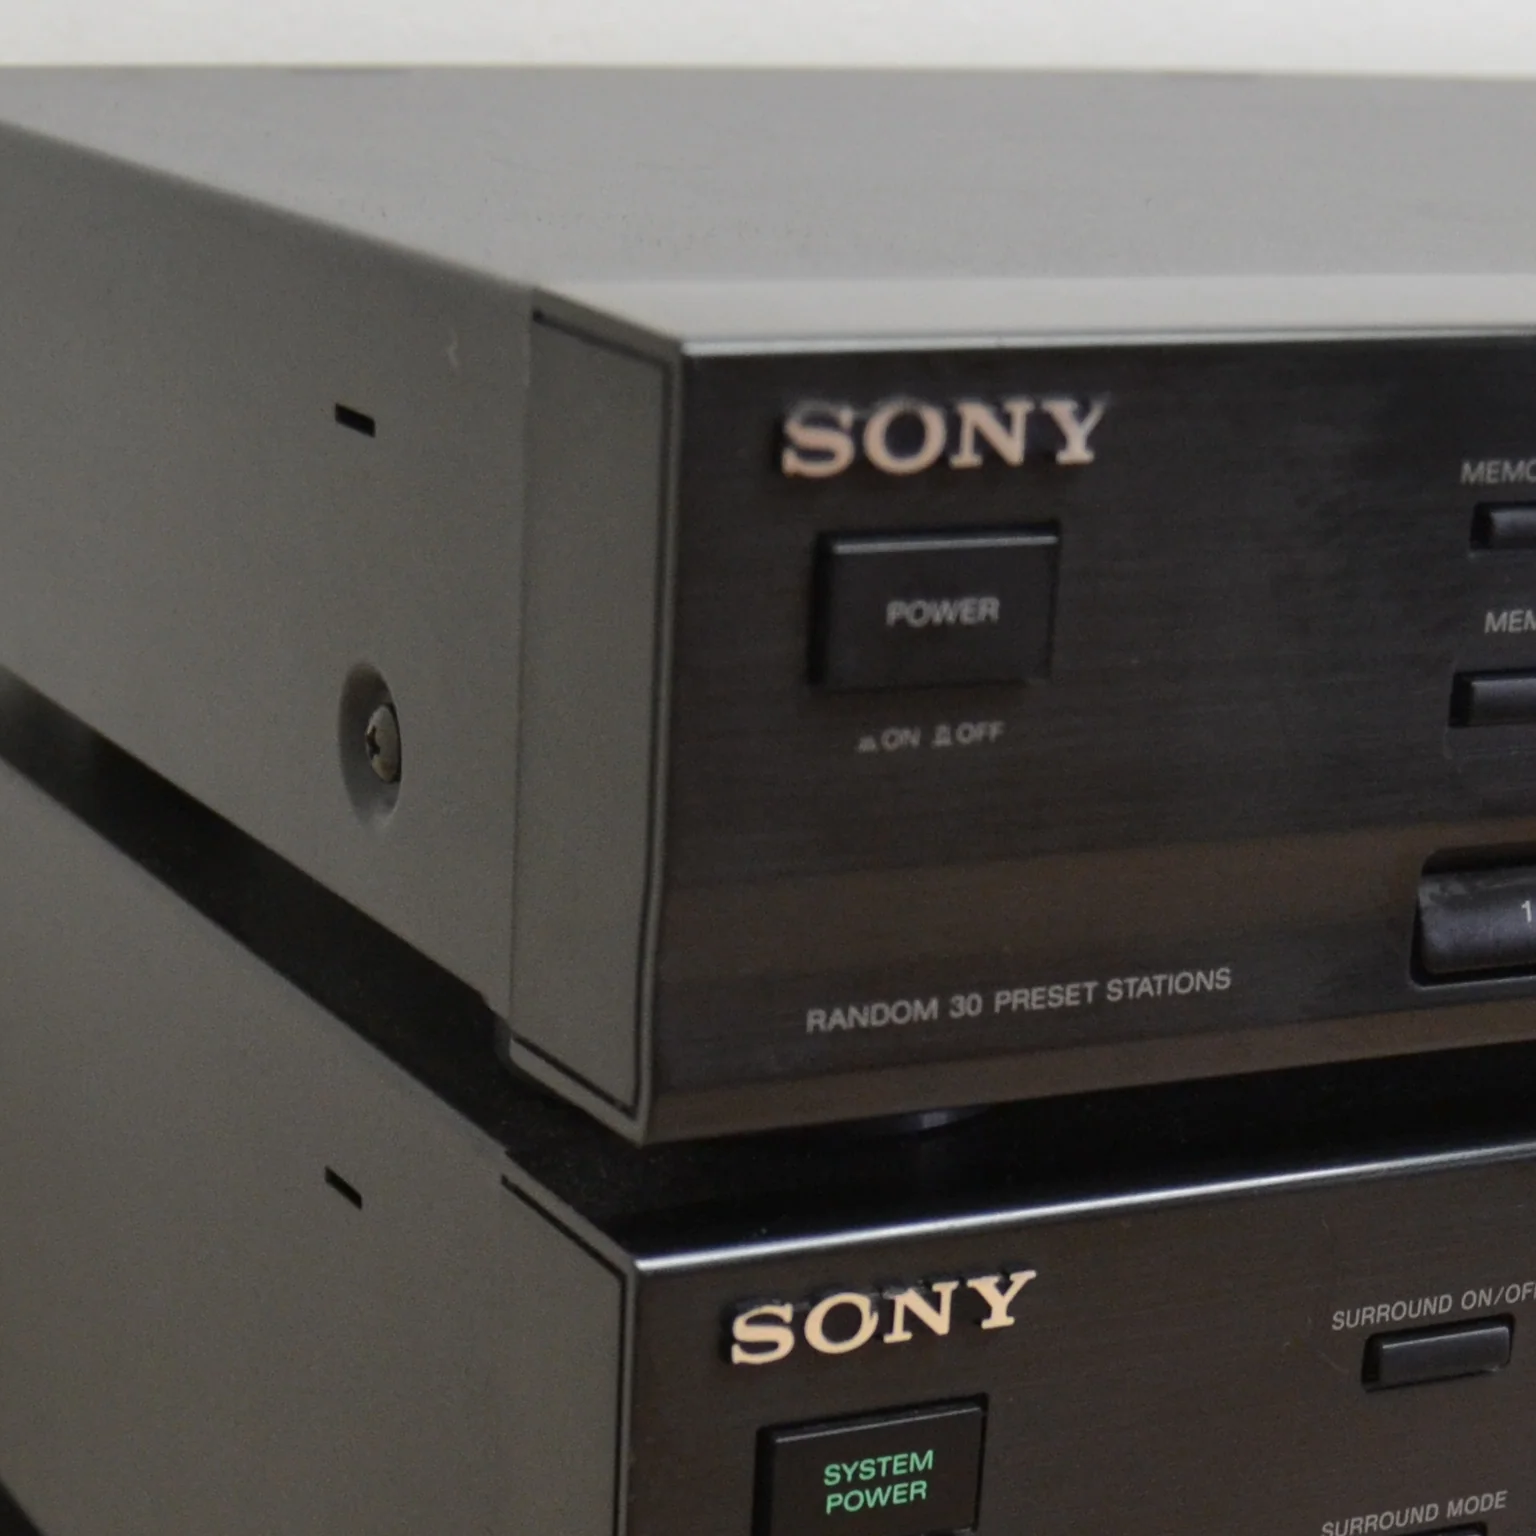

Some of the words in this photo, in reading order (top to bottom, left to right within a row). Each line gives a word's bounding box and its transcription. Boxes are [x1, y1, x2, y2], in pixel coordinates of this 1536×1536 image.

[781, 396, 1111, 478] SONY
[885, 596, 1001, 628] POWER
[880, 726, 922, 750] ON
[955, 721, 1005, 746] OFF
[1520, 900, 1533, 923] 1
[806, 998, 939, 1034] RANDOM
[949, 992, 983, 1019] 30
[994, 980, 1099, 1014] PRESET
[1106, 967, 1232, 1001] STATIONS
[730, 1269, 1037, 1365] SONY
[1331, 1293, 1453, 1331] SURROUND
[823, 1449, 935, 1486] SYSTEM
[825, 1479, 928, 1516] POWER
[1446, 1490, 1509, 1520] MODE
